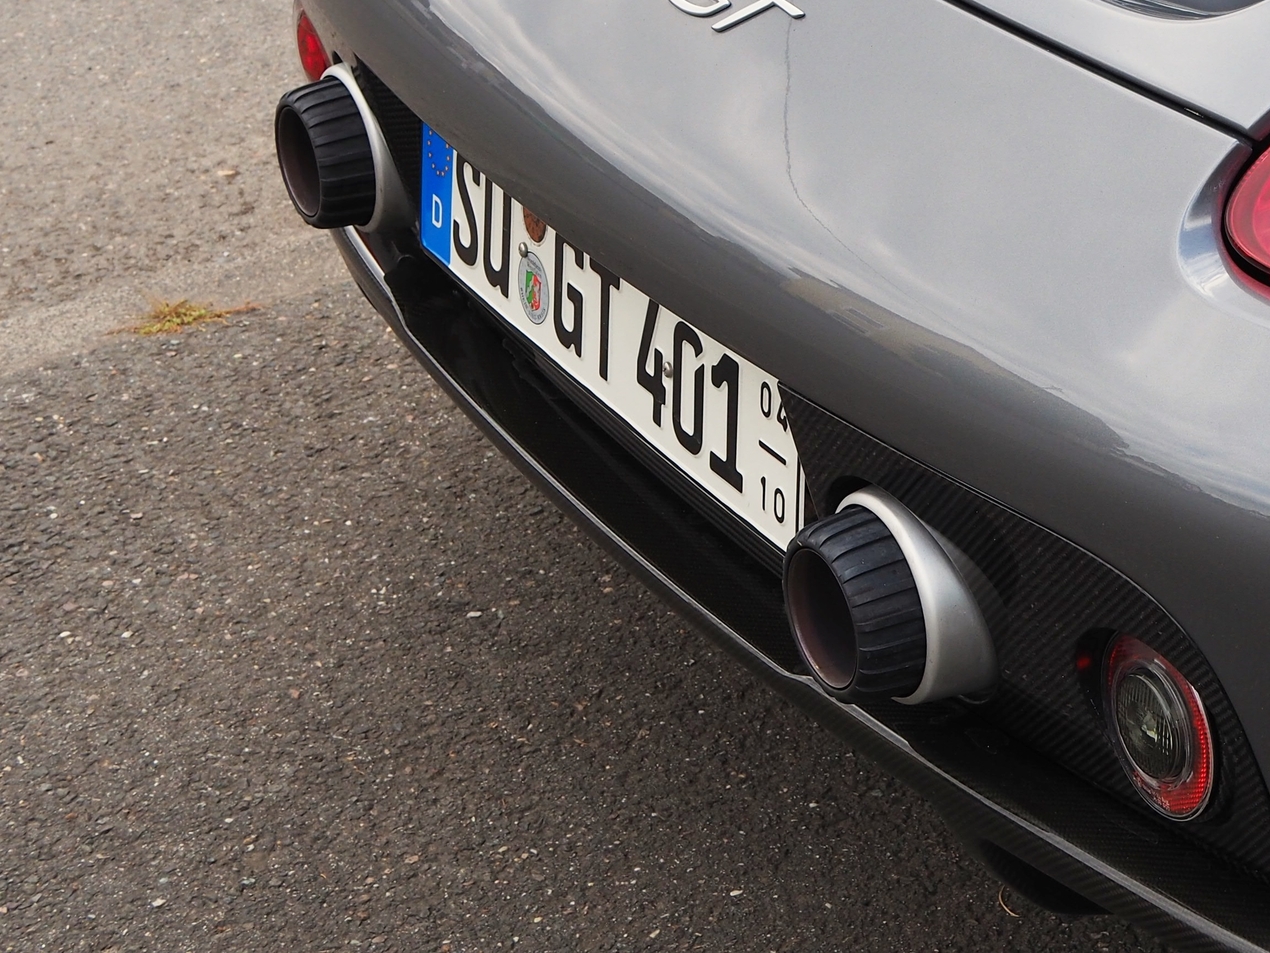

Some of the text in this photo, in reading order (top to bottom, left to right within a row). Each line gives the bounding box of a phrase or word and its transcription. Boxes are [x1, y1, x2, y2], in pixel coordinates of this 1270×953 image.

[431, 193, 443, 229] D
[452, 148, 744, 494] SU GT 401
[760, 476, 785, 524] 10
